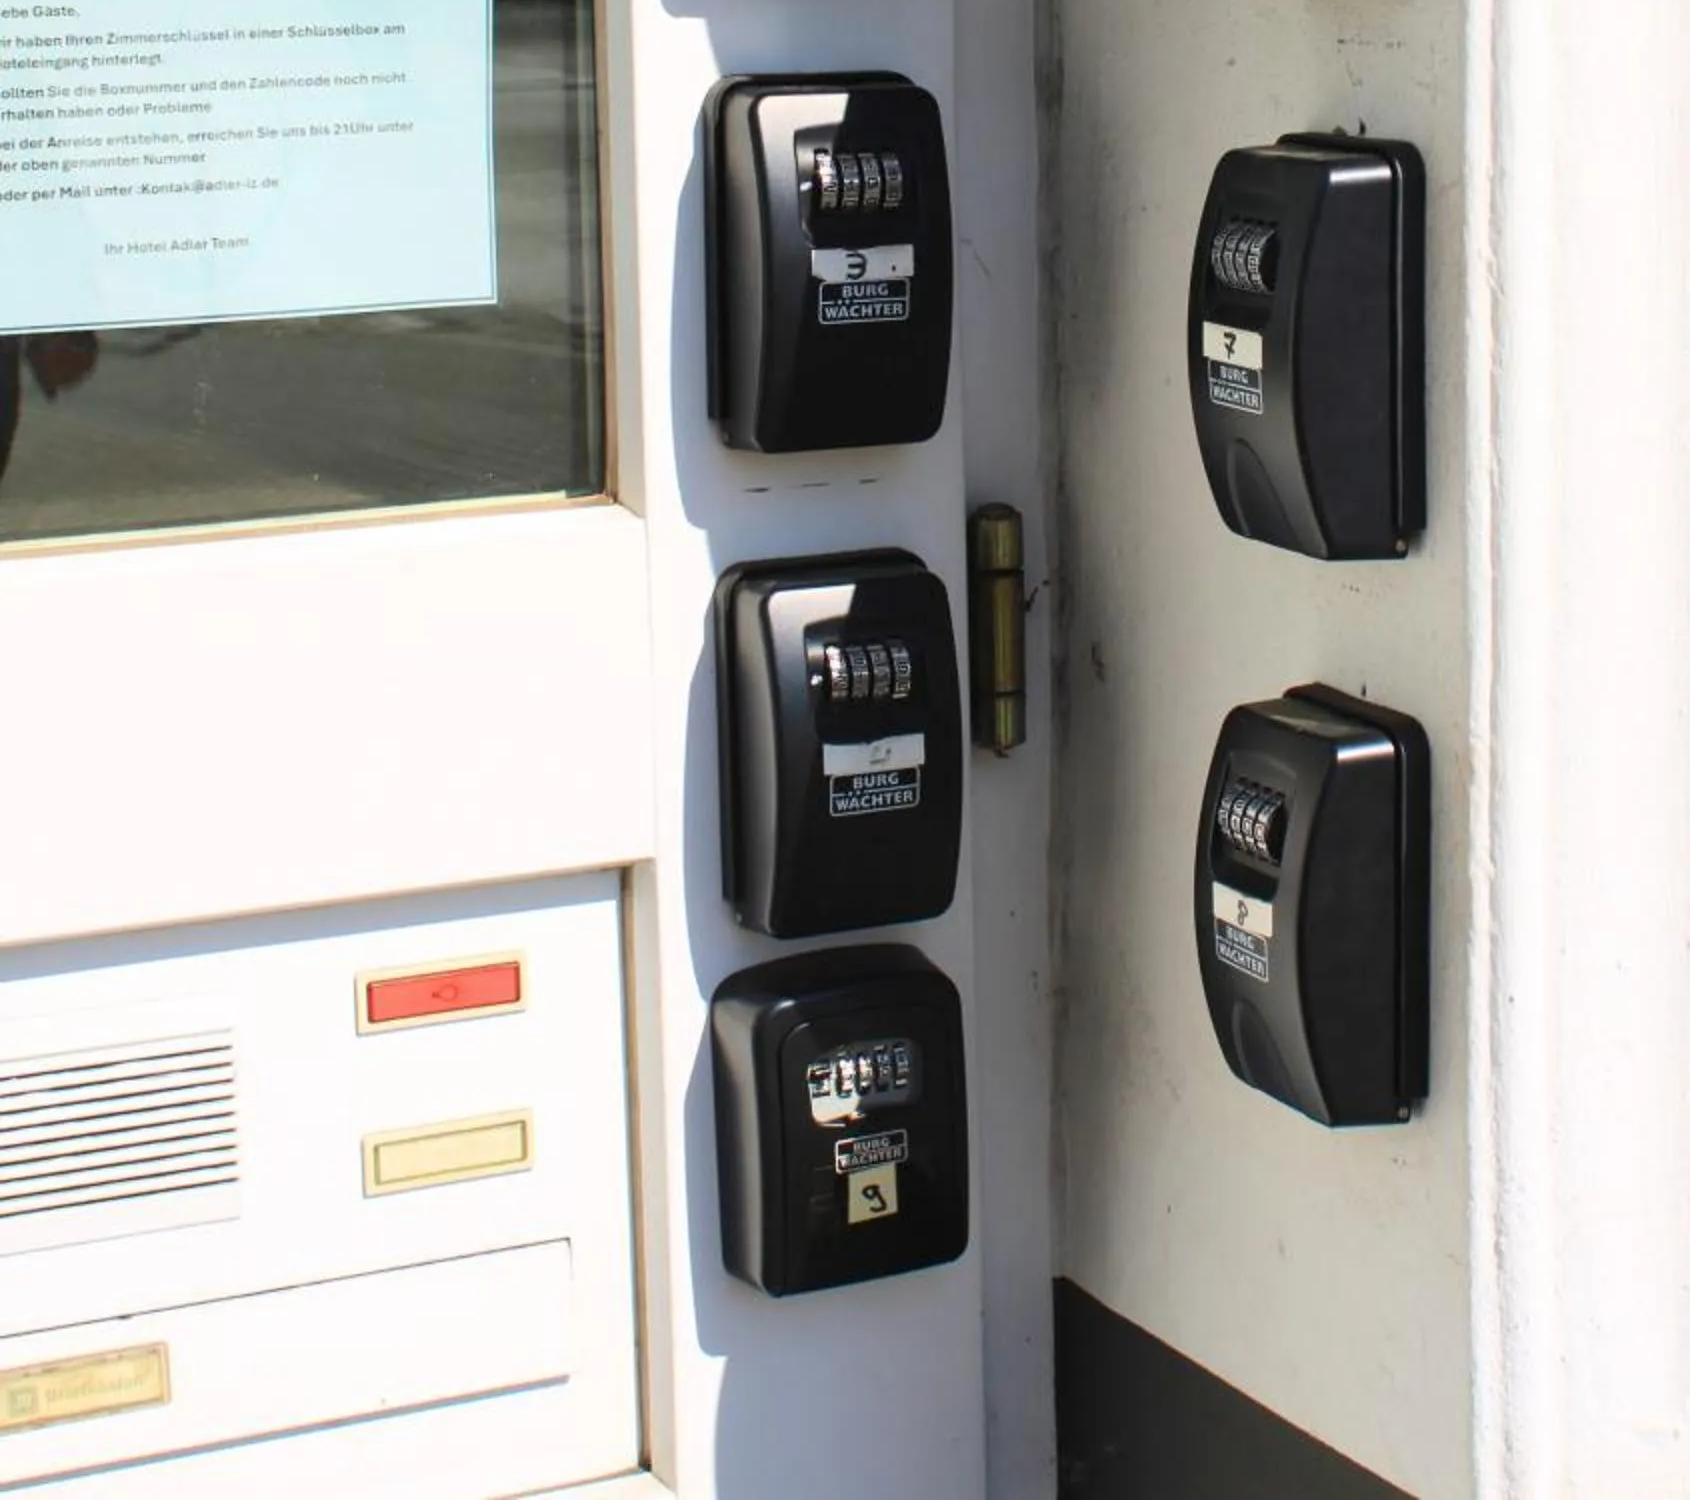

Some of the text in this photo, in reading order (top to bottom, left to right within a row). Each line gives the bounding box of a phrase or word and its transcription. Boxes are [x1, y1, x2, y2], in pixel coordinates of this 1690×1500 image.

[383, 23, 406, 37] am
[47, 83, 71, 99] Sie
[107, 102, 141, 118] oder
[143, 100, 214, 117] Probleme
[256, 125, 280, 140] Sie
[59, 183, 92, 199] Mail
[845, 252, 868, 281] 3
[842, 282, 889, 298] BURG
[824, 298, 904, 321] WÄCHTER
[1223, 330, 1238, 360] 7
[1219, 364, 1249, 385] BURG
[853, 771, 900, 790] BURG
[836, 789, 914, 812] WÄCHTER
[861, 1184, 888, 1213] 9
